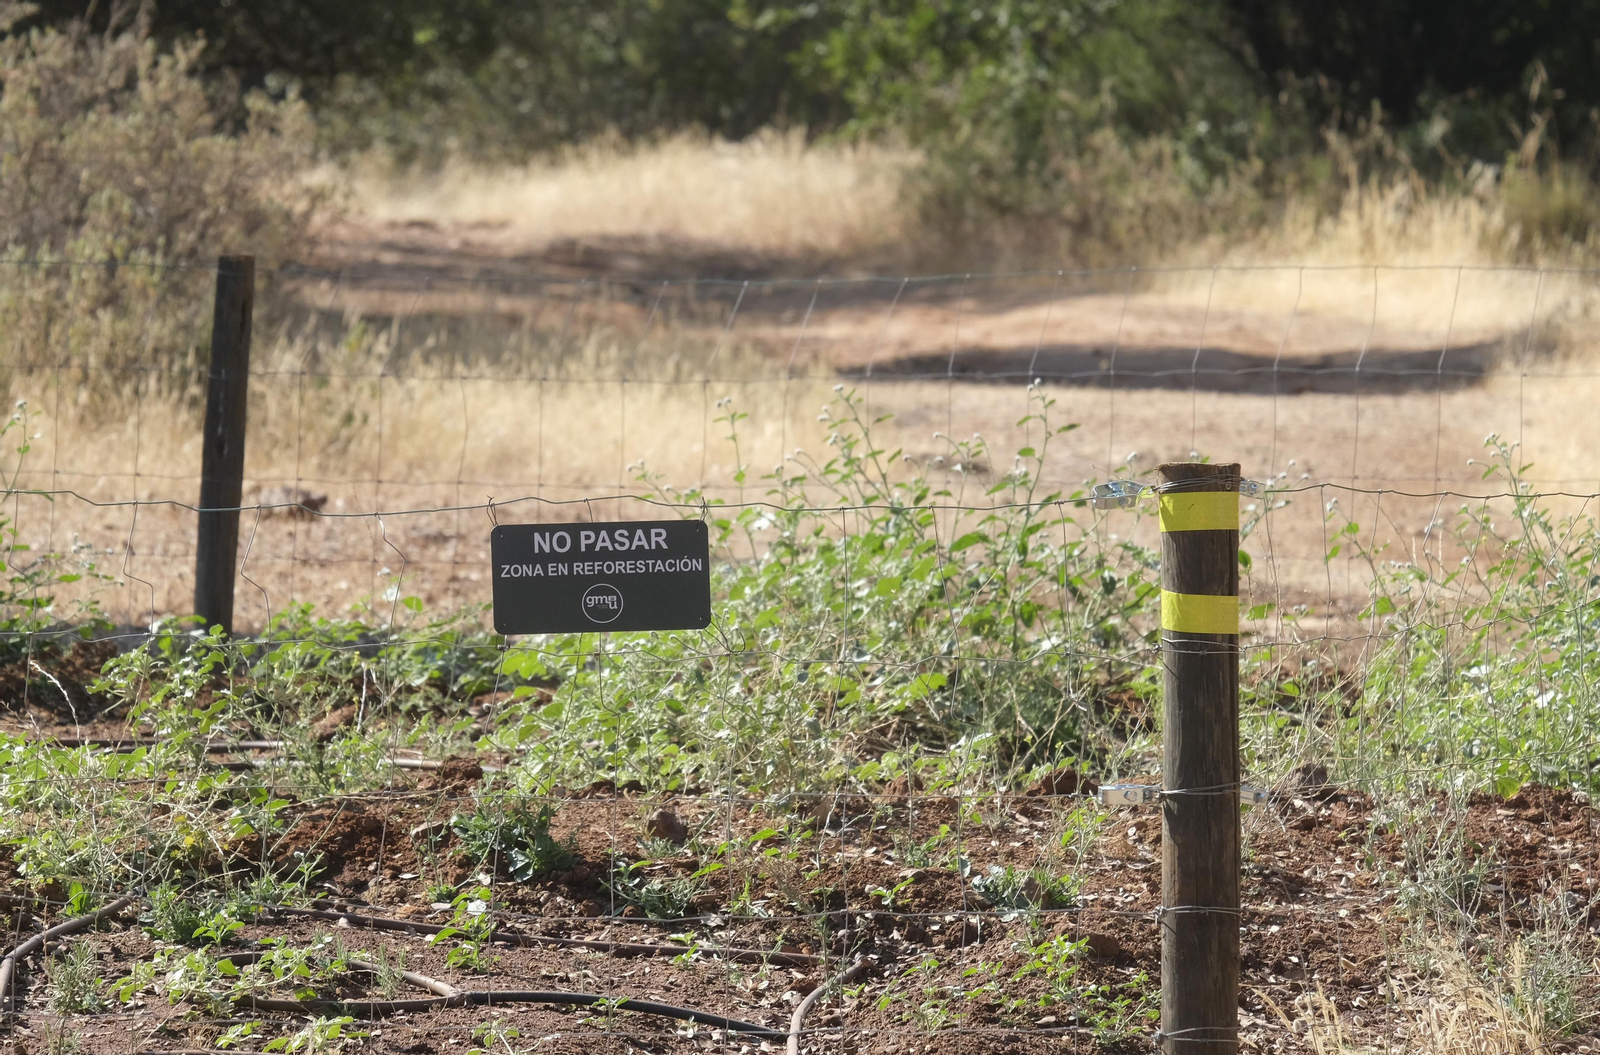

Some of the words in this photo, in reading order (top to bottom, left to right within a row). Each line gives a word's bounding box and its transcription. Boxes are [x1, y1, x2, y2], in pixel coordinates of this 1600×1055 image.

[533, 531, 571, 553] NO
[580, 528, 668, 551] PASAR
[501, 564, 544, 578] ZONA
[548, 563, 568, 576] EN
[573, 555, 702, 575] REFORESTACIÓN
